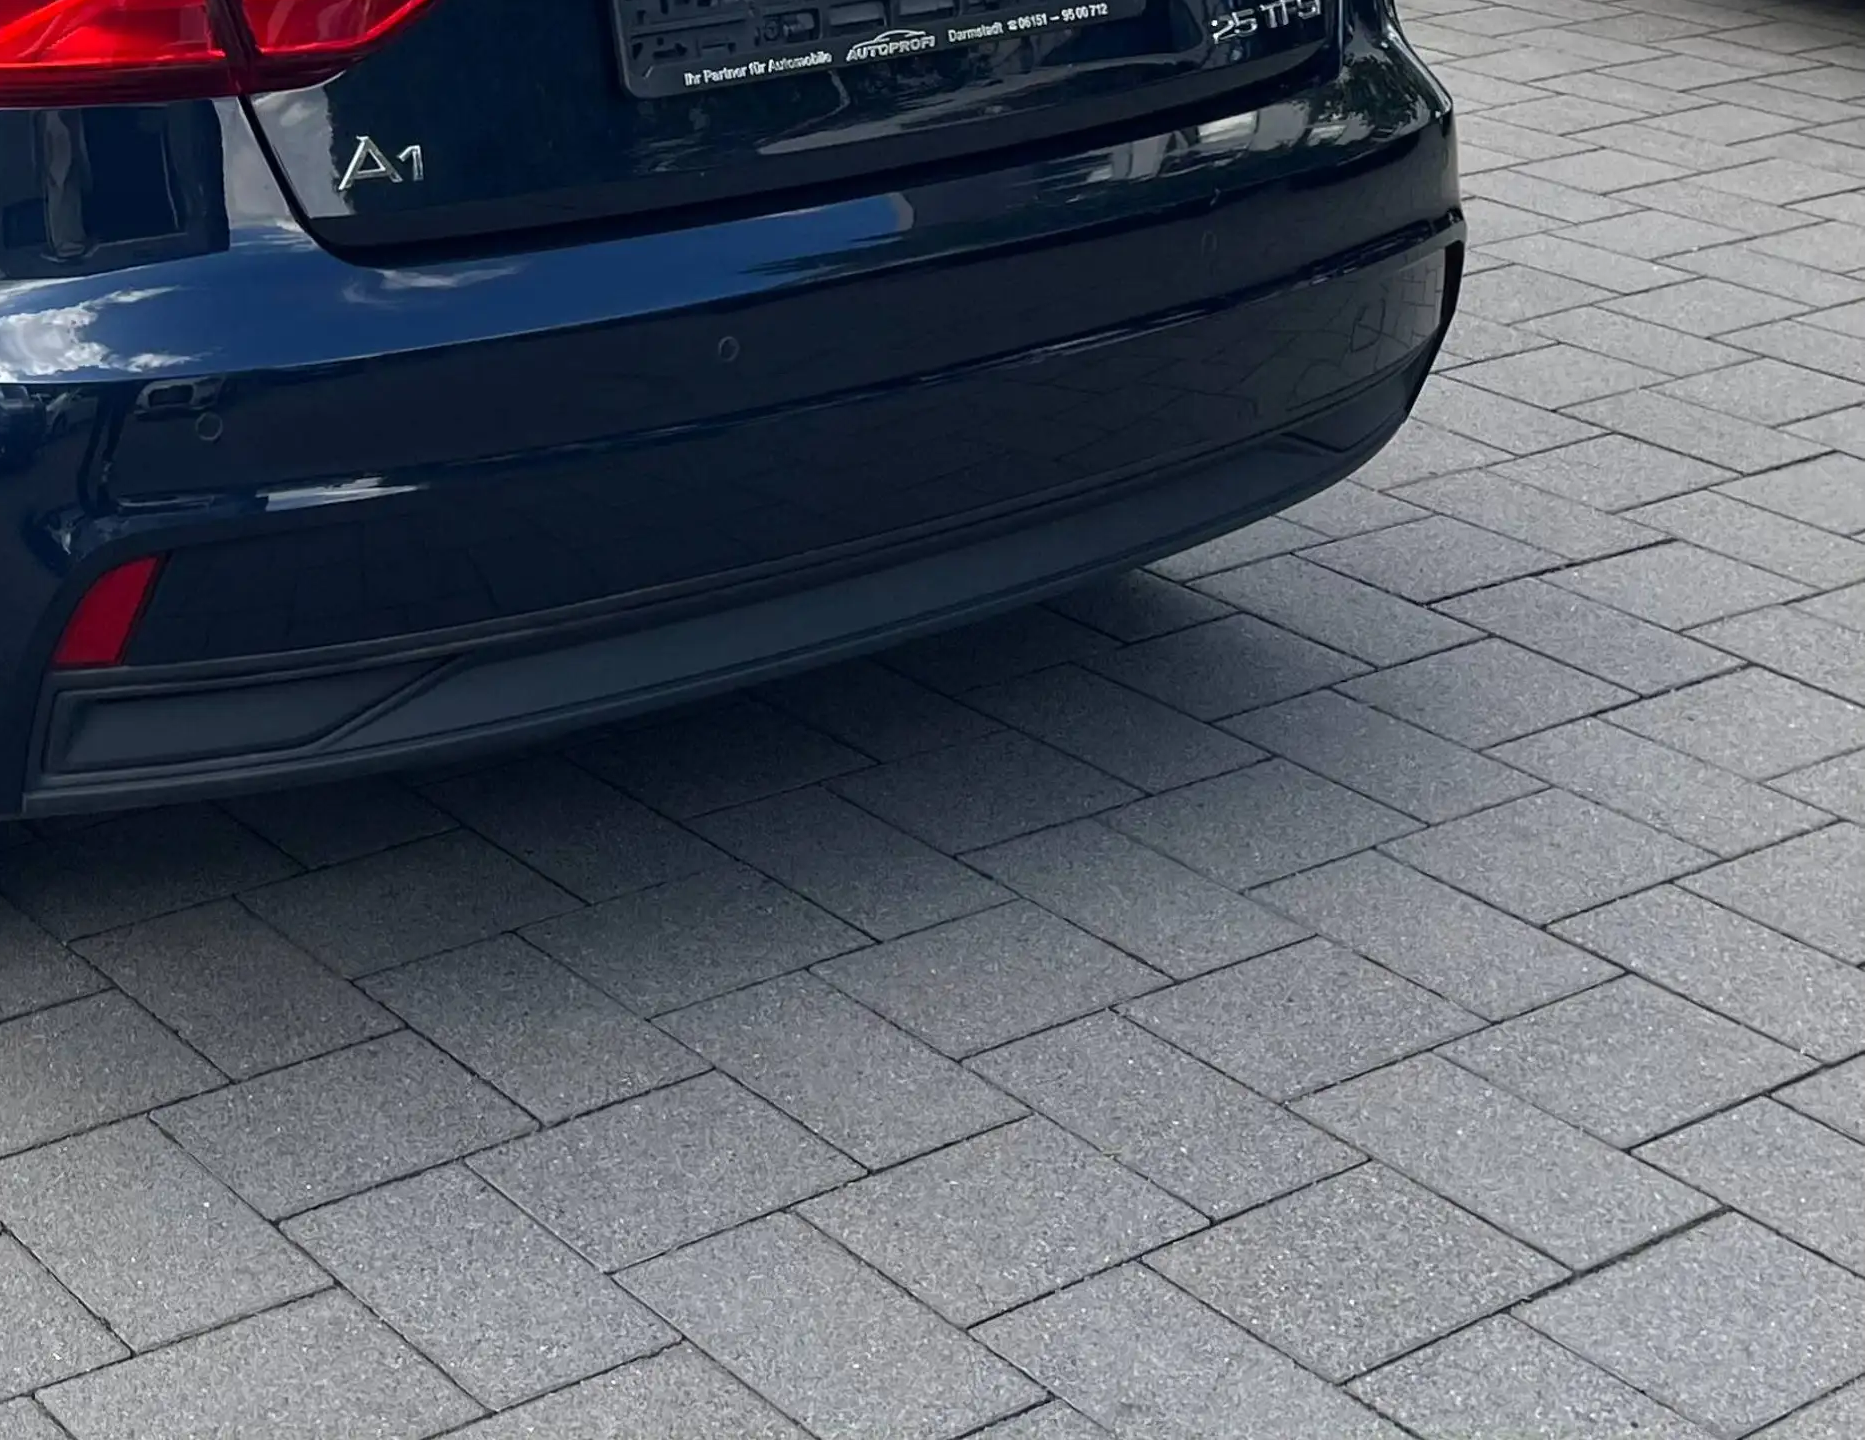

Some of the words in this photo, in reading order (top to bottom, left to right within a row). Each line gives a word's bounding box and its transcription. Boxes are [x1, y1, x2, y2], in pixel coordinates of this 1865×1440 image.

[684, 71, 702, 87] Ihr
[704, 64, 748, 84] Partner
[749, 60, 766, 76] für
[768, 50, 833, 74] Automobile
[845, 35, 936, 62] AUTOPROFI
[948, 21, 1004, 43] Darmstadt
[1018, 13, 1048, 30] 06151
[1088, 3, 1109, 17] 712
[1210, 8, 1258, 45] 25
[338, 135, 424, 190] A1
